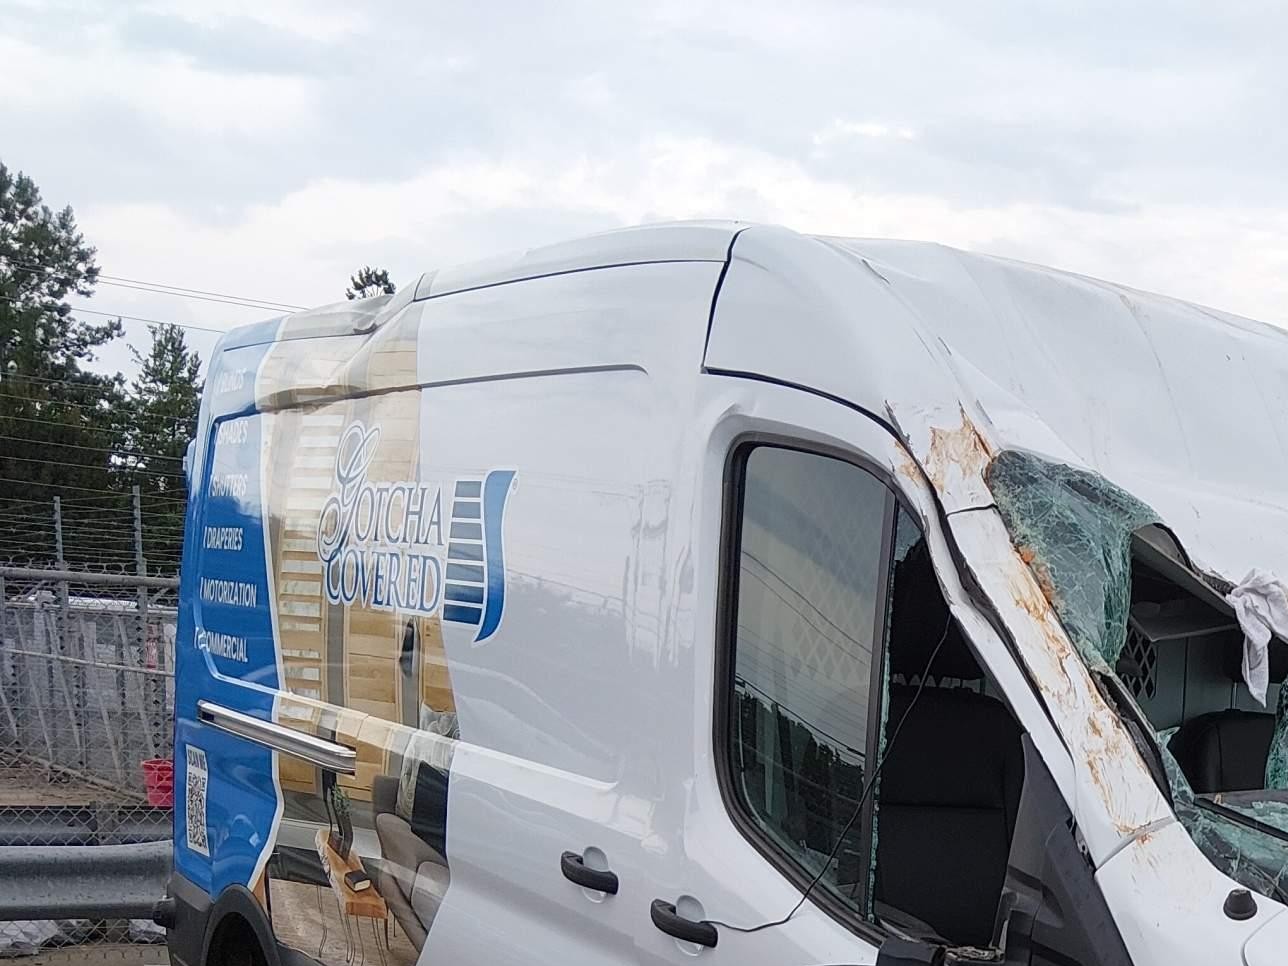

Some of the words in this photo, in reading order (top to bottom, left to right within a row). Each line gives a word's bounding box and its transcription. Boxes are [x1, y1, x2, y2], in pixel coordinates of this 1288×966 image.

[212, 473, 248, 497] SHUTTERS
[207, 527, 243, 551] DRAPERIES
[204, 580, 257, 608] MOTORIZATION
[326, 549, 441, 613] COVERED
